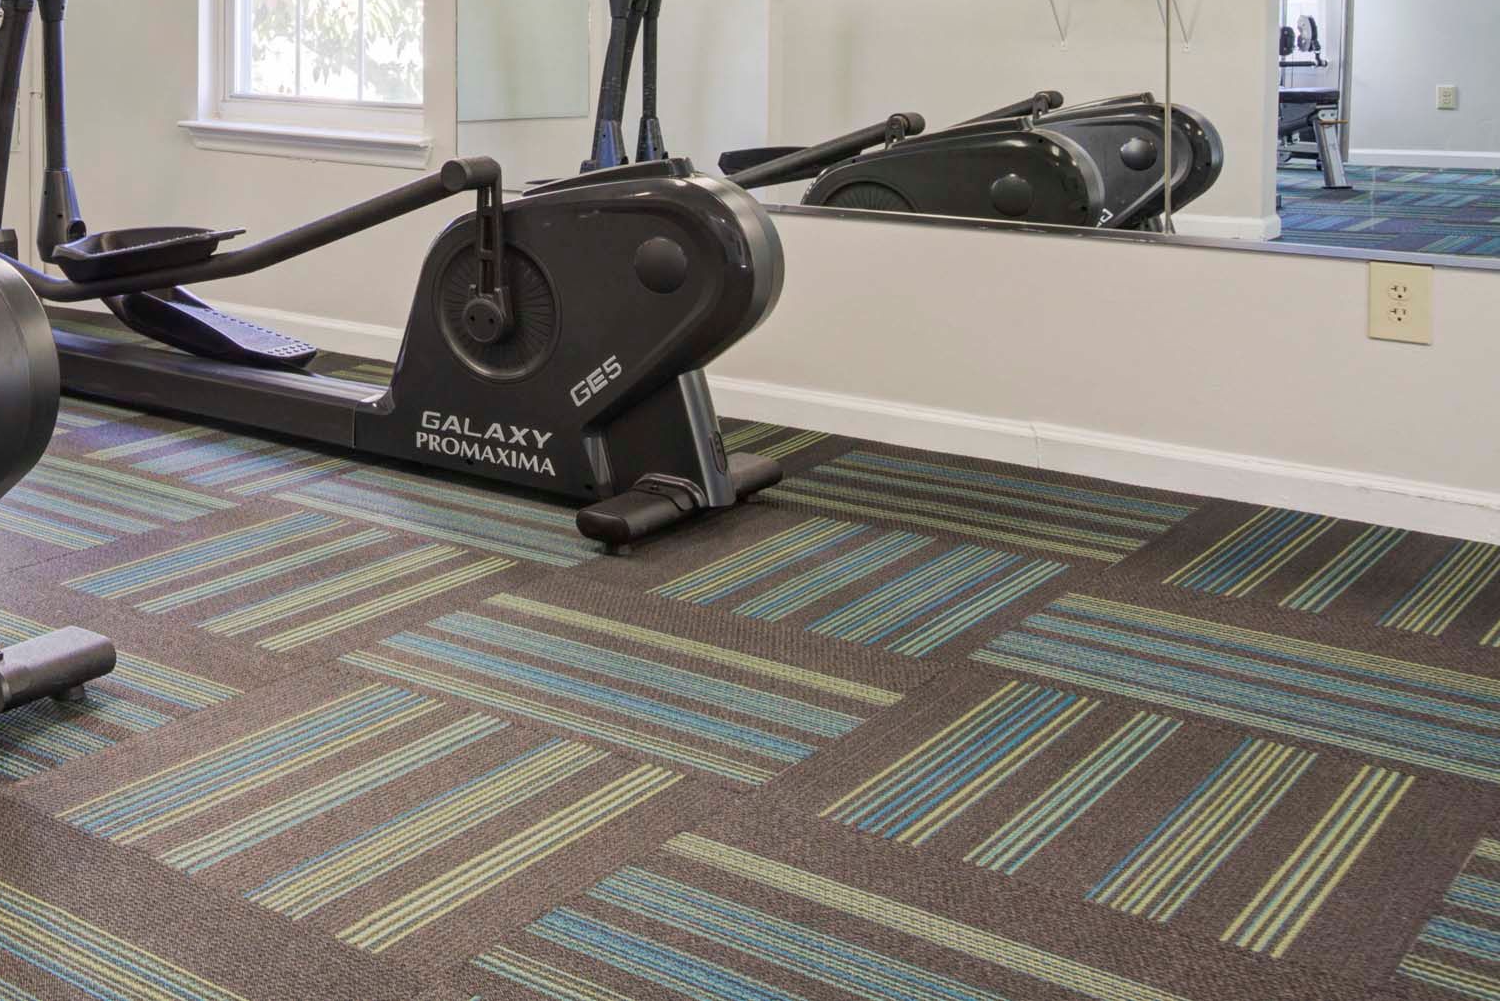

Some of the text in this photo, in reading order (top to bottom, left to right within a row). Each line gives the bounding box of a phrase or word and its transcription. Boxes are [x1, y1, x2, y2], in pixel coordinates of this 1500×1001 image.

[570, 354, 622, 407] GE5
[421, 410, 553, 449] GALAXY
[415, 431, 556, 477] PROMAXIMA
